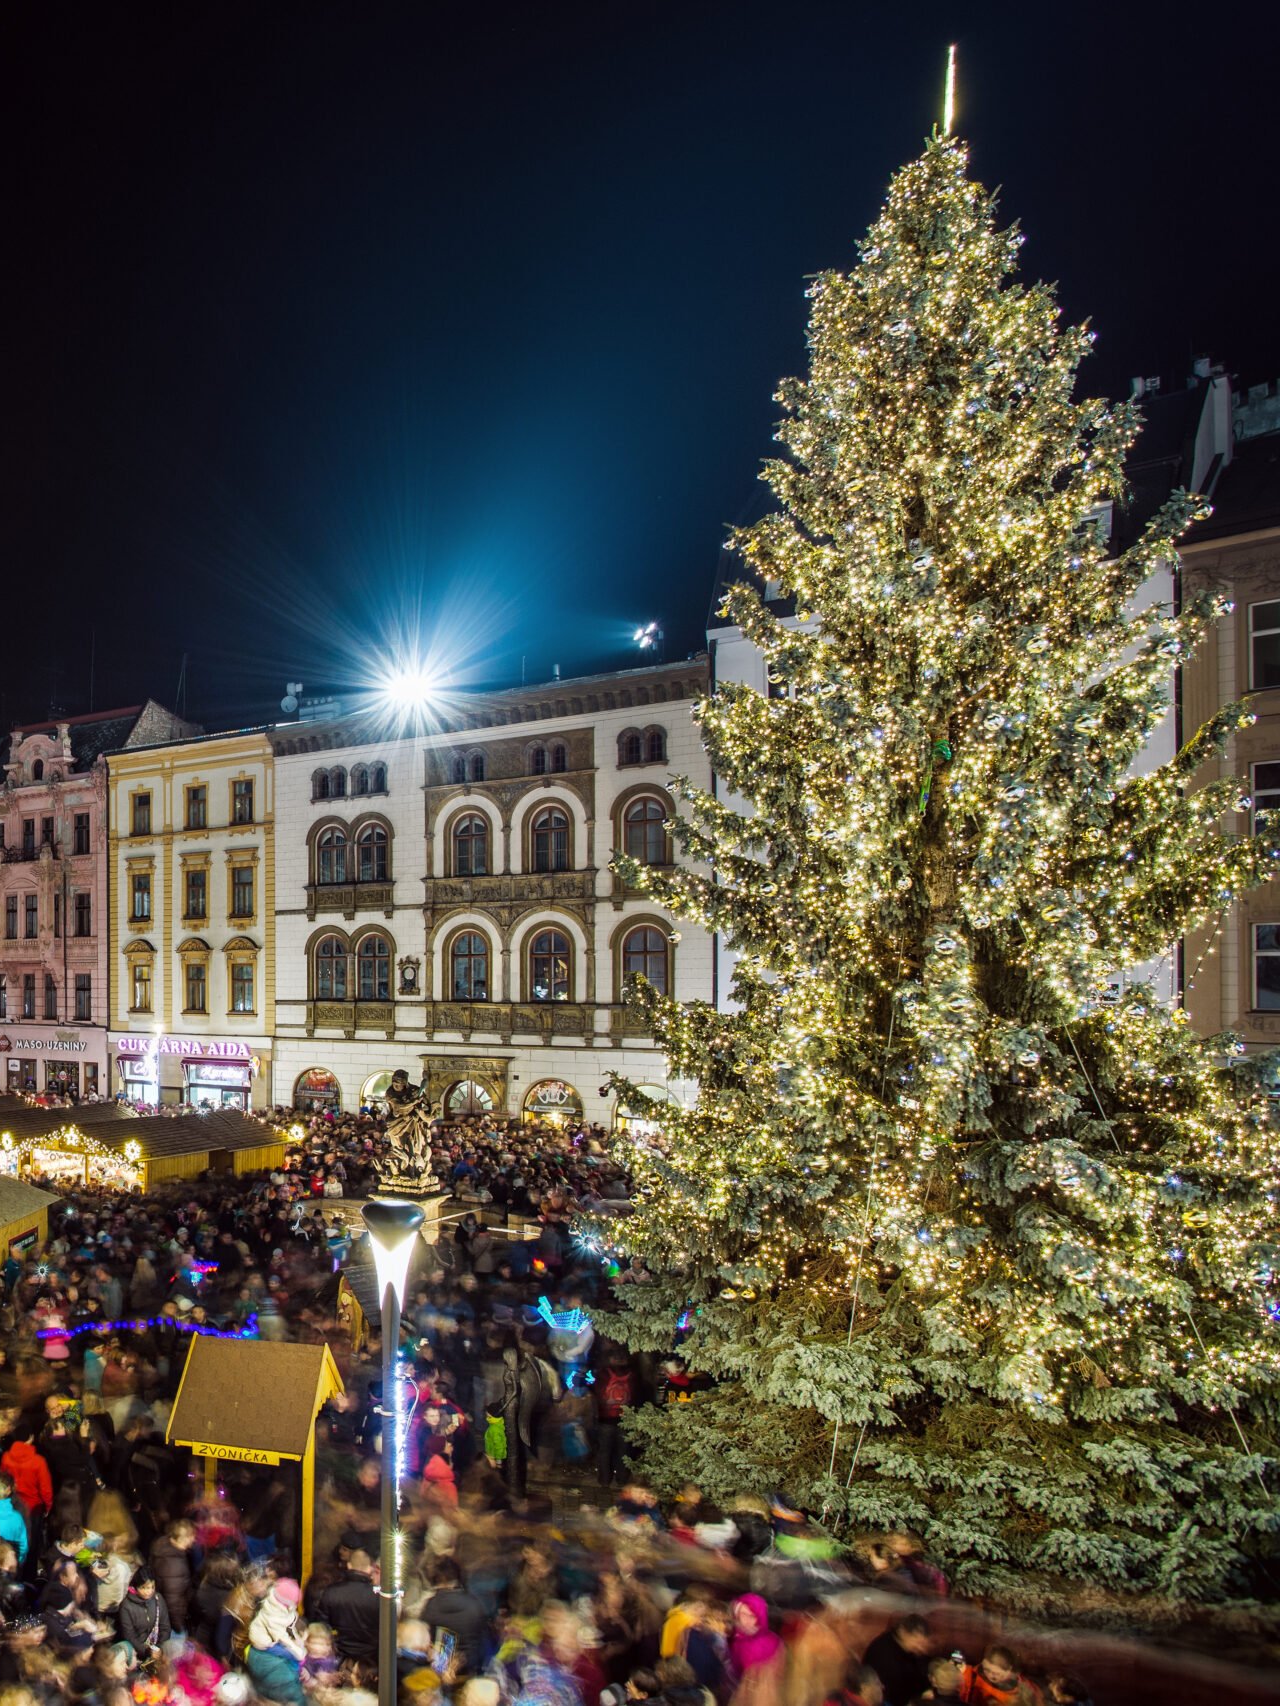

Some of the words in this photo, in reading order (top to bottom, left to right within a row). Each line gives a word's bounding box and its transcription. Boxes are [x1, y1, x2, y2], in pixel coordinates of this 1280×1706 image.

[118, 1037, 203, 1055] CUKÁRNA
[207, 1042, 250, 1056] AIDA
[199, 1444, 268, 1463] ZVONIČKA
